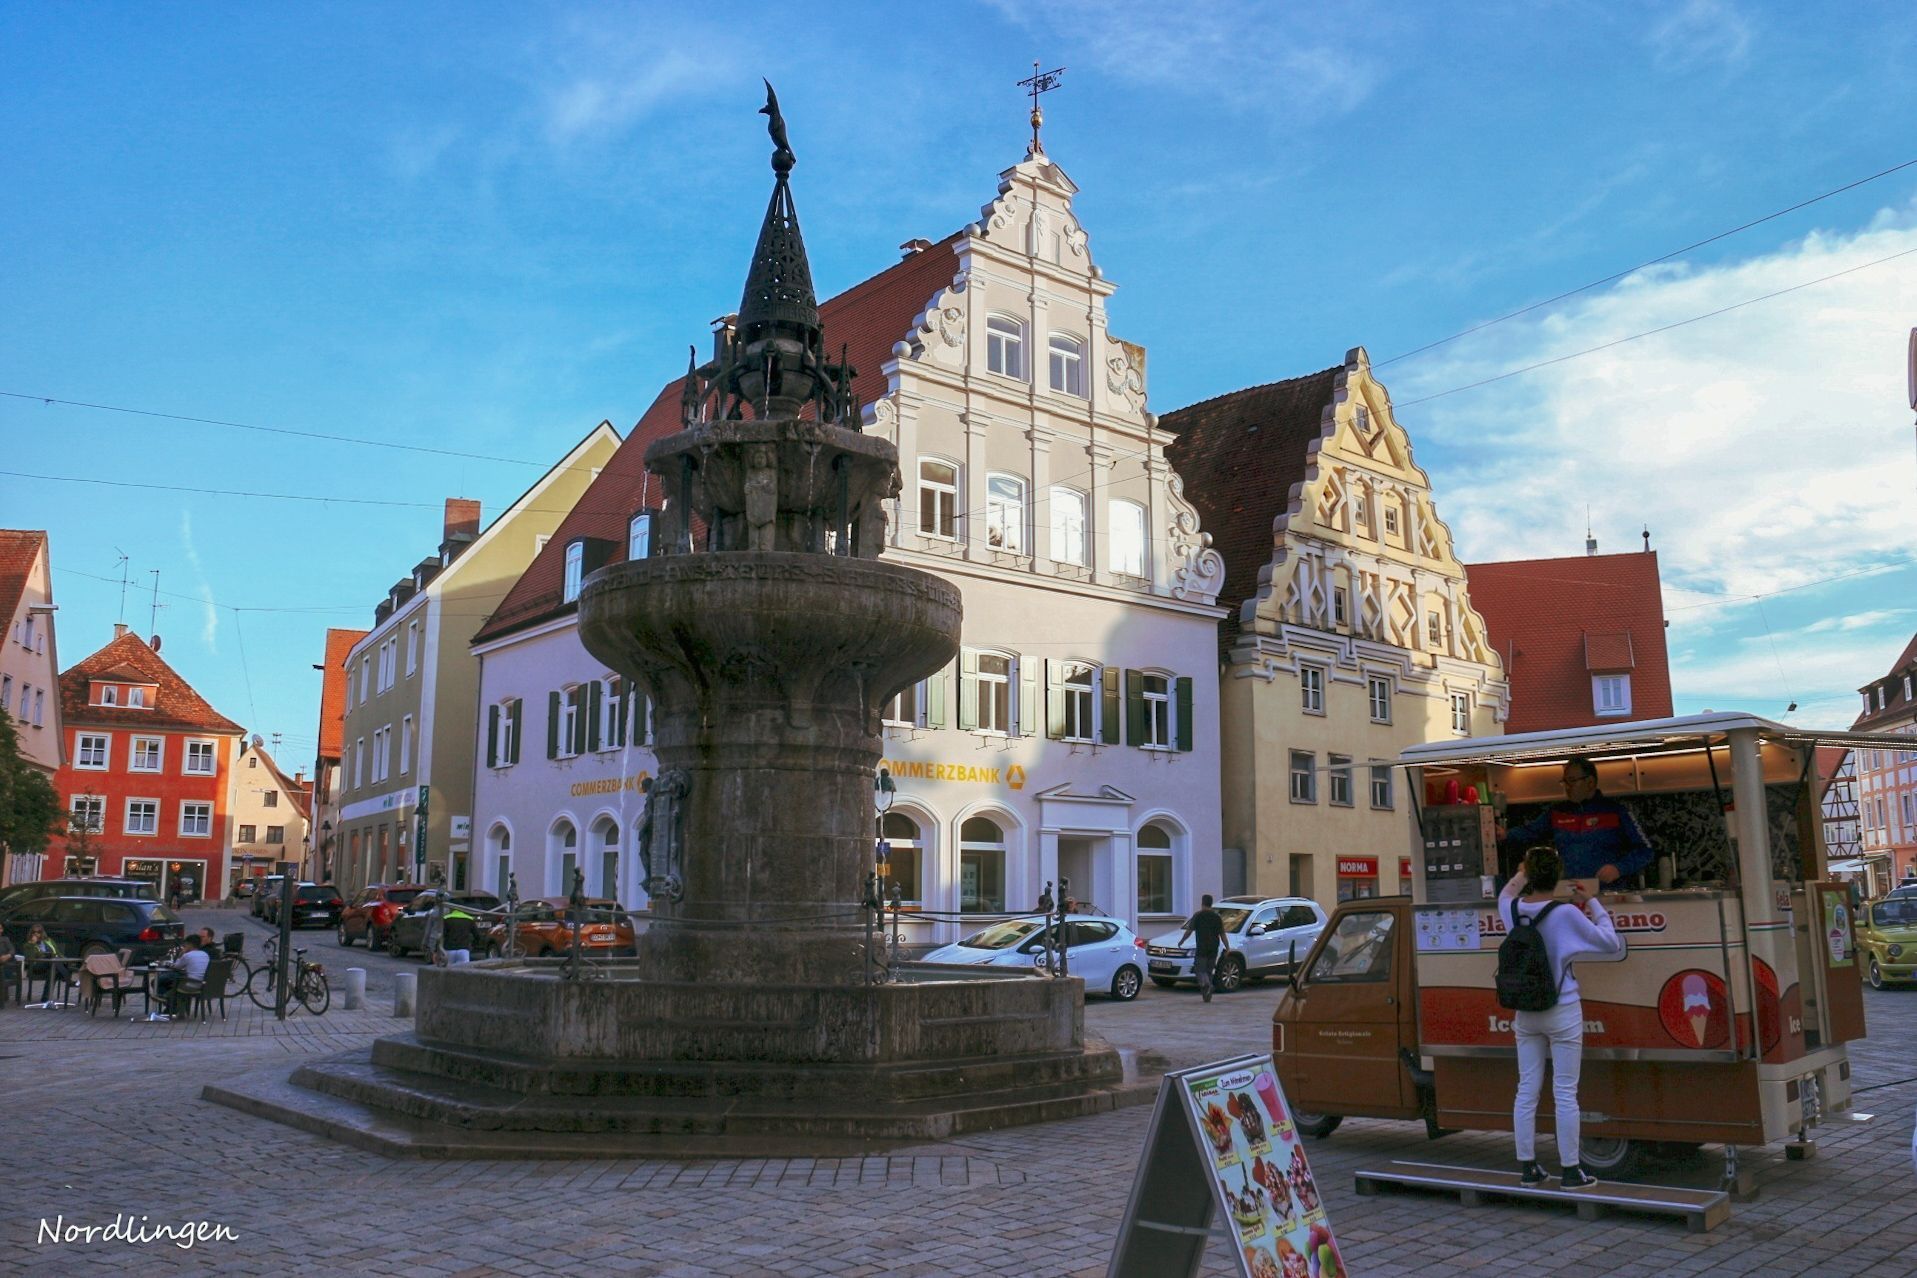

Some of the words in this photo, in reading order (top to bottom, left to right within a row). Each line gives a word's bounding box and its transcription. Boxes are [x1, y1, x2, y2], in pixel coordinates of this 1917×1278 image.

[879, 758, 1001, 784] OMMERZBANK
[1340, 862, 1369, 873] NORMA
[1478, 914, 1507, 932] ela
[1789, 1016, 1801, 1034] Ice
